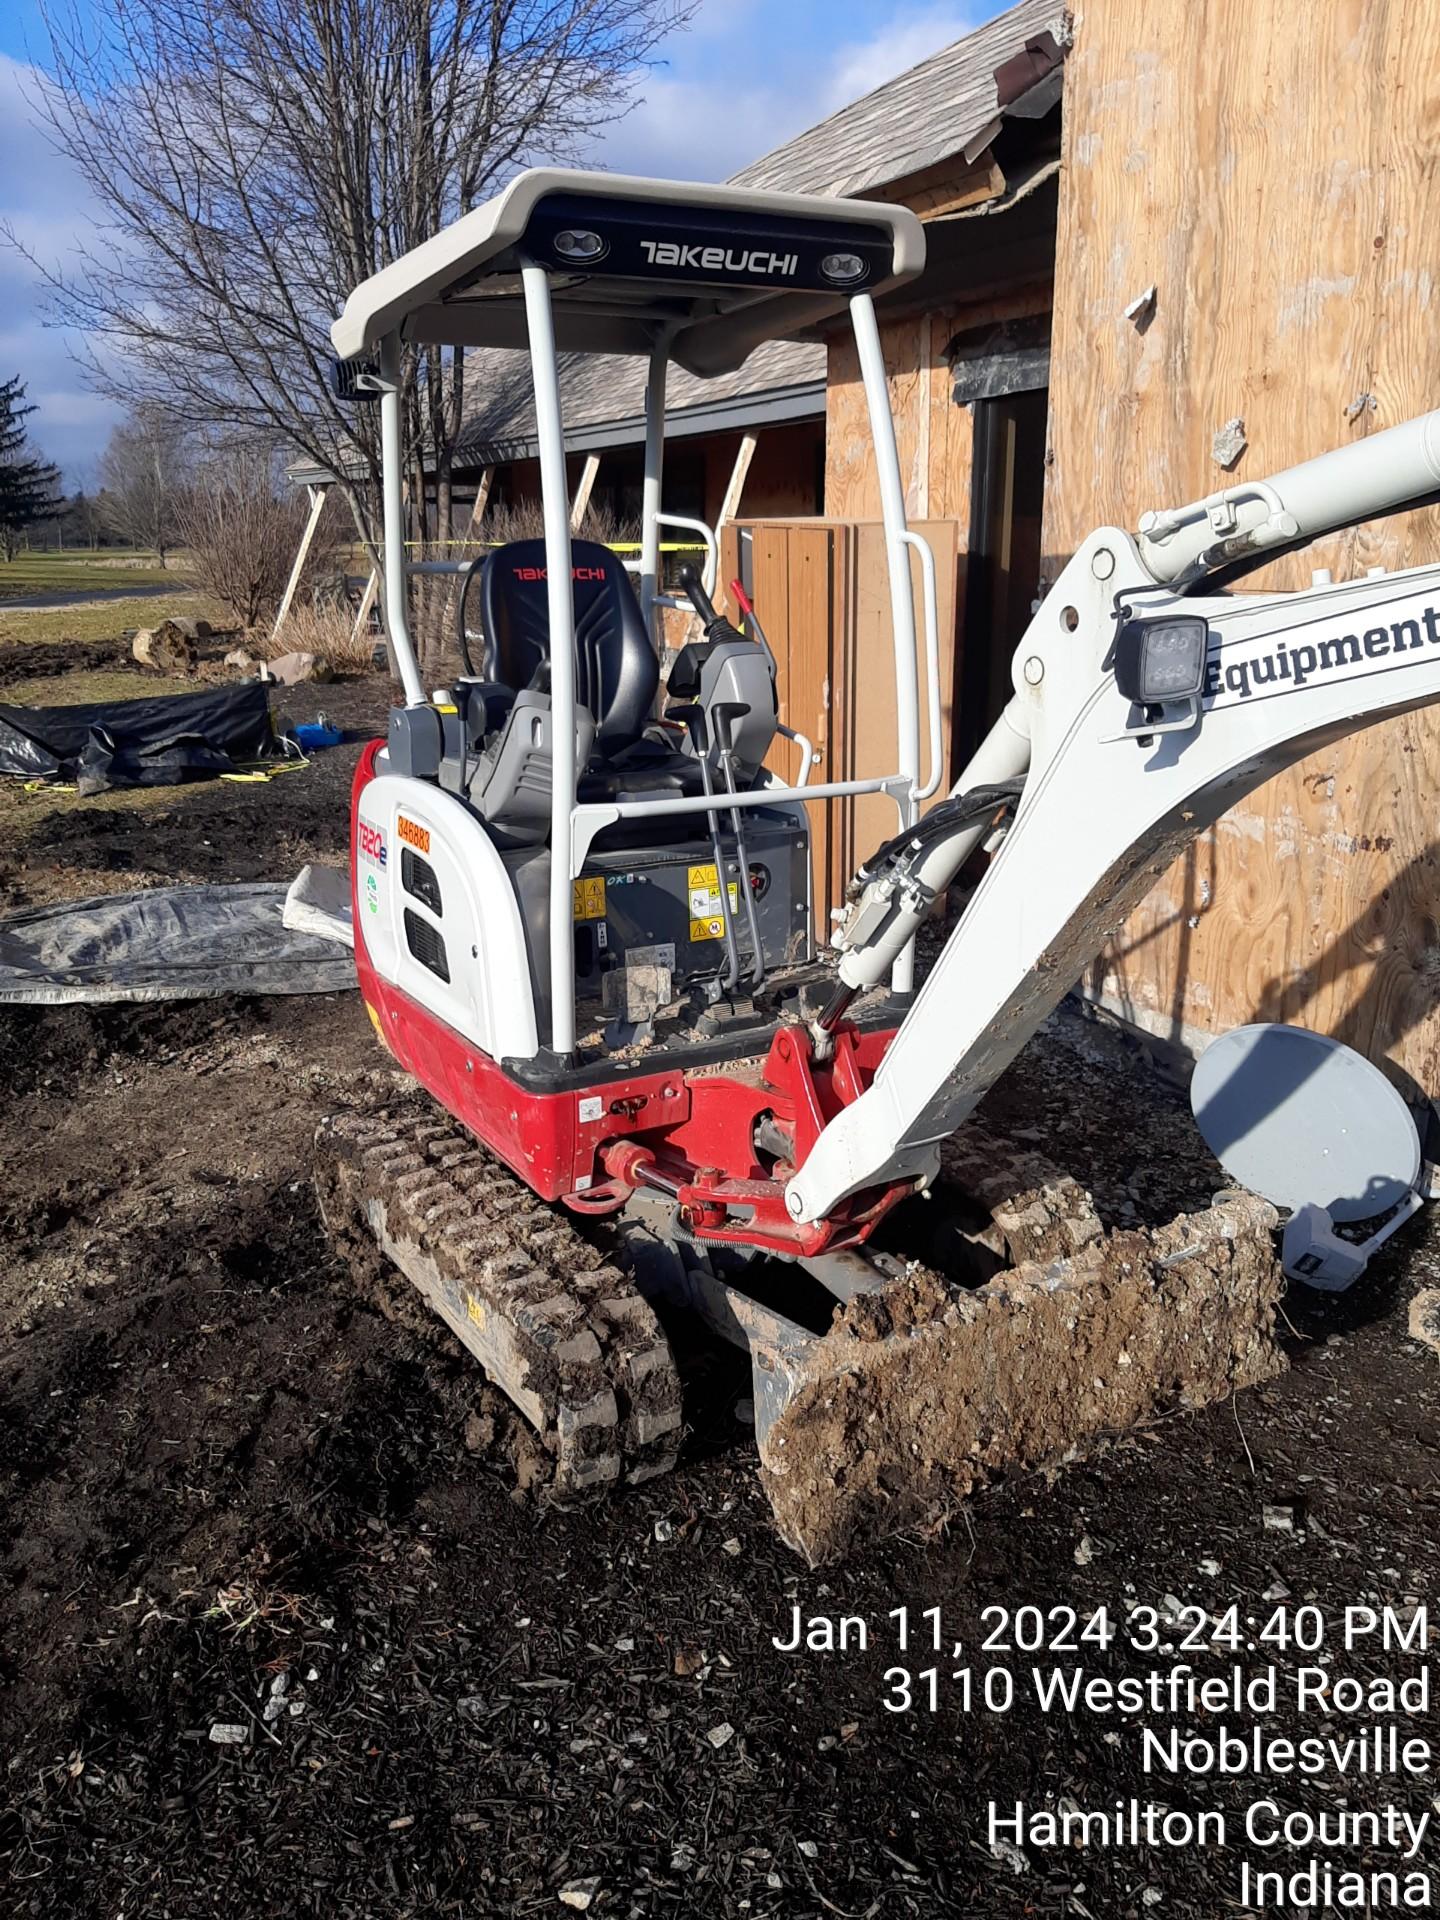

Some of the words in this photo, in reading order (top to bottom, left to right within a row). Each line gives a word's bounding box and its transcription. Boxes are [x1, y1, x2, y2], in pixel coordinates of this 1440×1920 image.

[640, 241, 799, 275] TAKEUCHI
[513, 567, 606, 581] TAKCHI
[1201, 607, 1440, 698] Equipment
